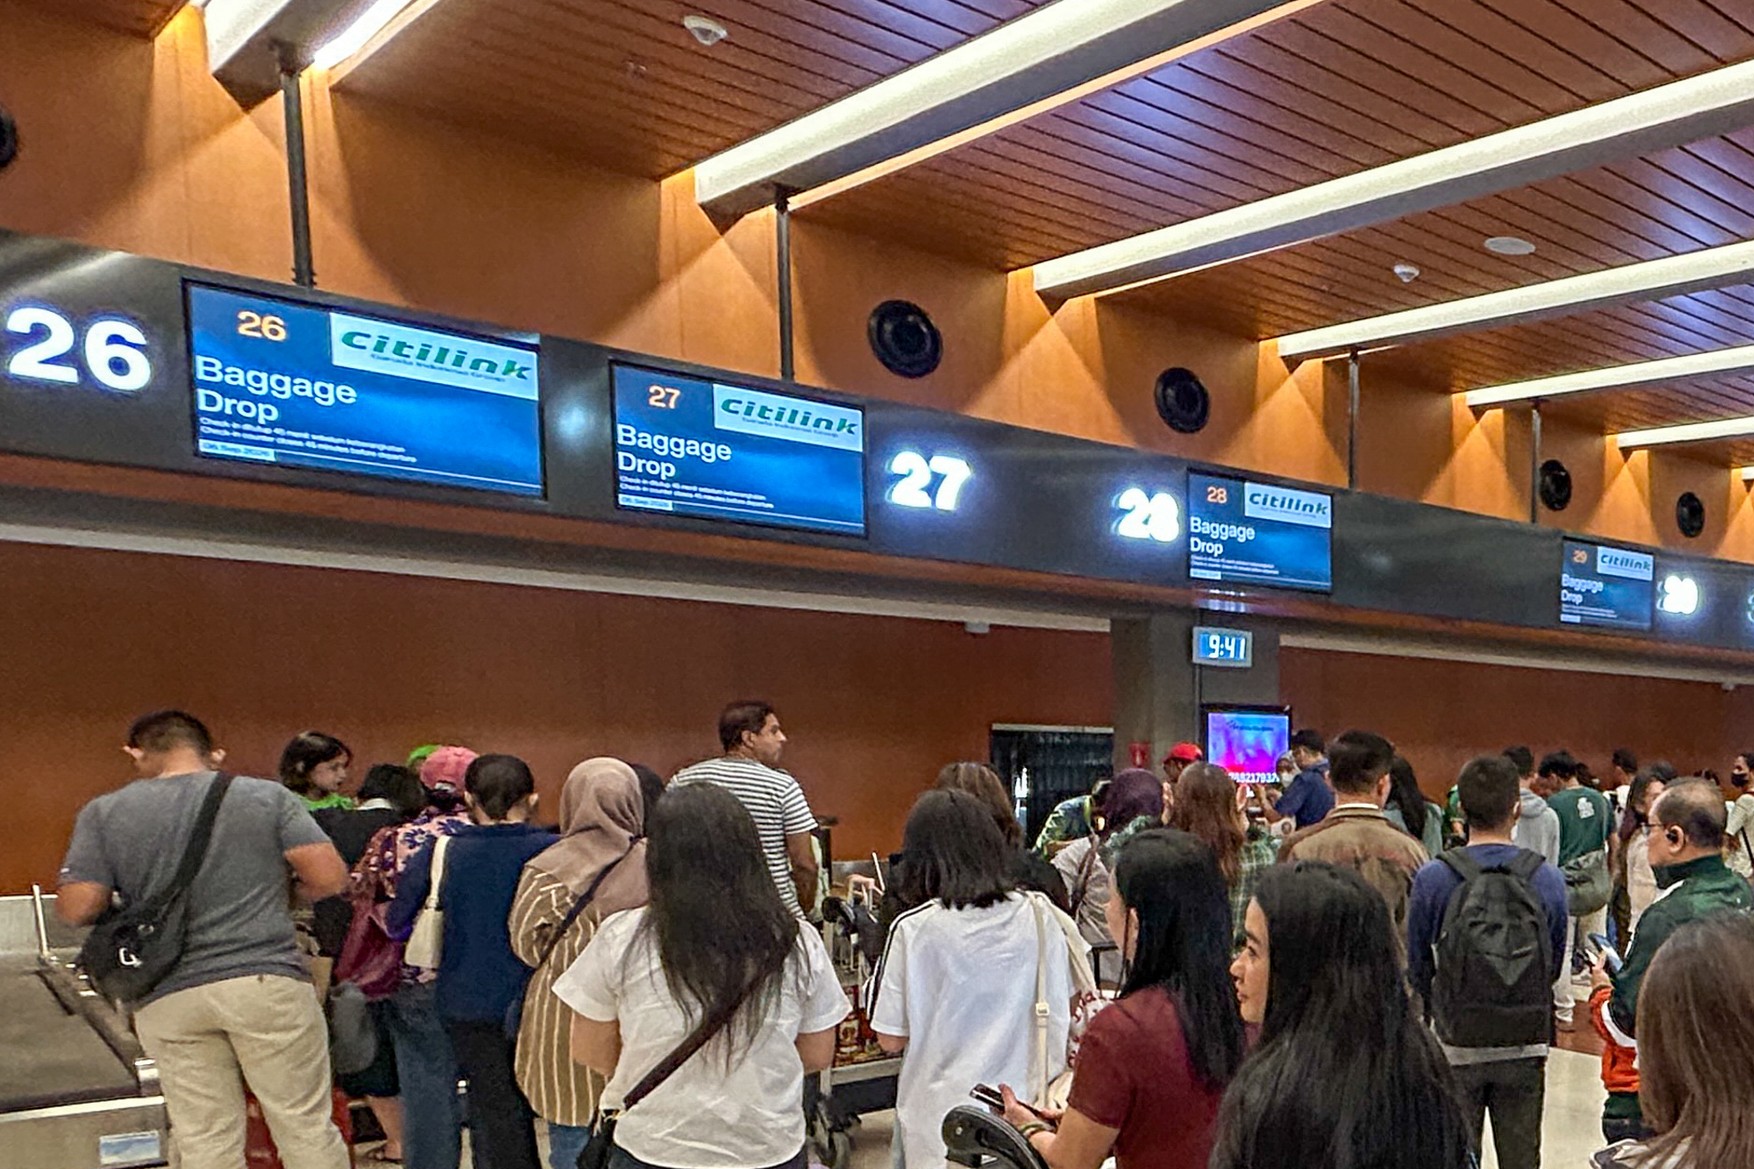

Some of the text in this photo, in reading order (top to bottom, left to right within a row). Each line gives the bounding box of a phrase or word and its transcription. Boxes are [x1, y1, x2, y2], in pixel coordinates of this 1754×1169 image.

[237, 310, 287, 341] 26
[6, 307, 151, 390] 26
[196, 355, 358, 406] Baggage
[198, 389, 279, 424] Drop
[648, 385, 681, 409] 27
[617, 423, 732, 462] Baggage
[617, 450, 676, 480] Drop
[890, 450, 973, 511] 27
[1207, 486, 1227, 504] 28
[1190, 516, 1255, 542] Baggage
[1190, 537, 1223, 557] Drop
[1208, 634, 1245, 660] 9:41
